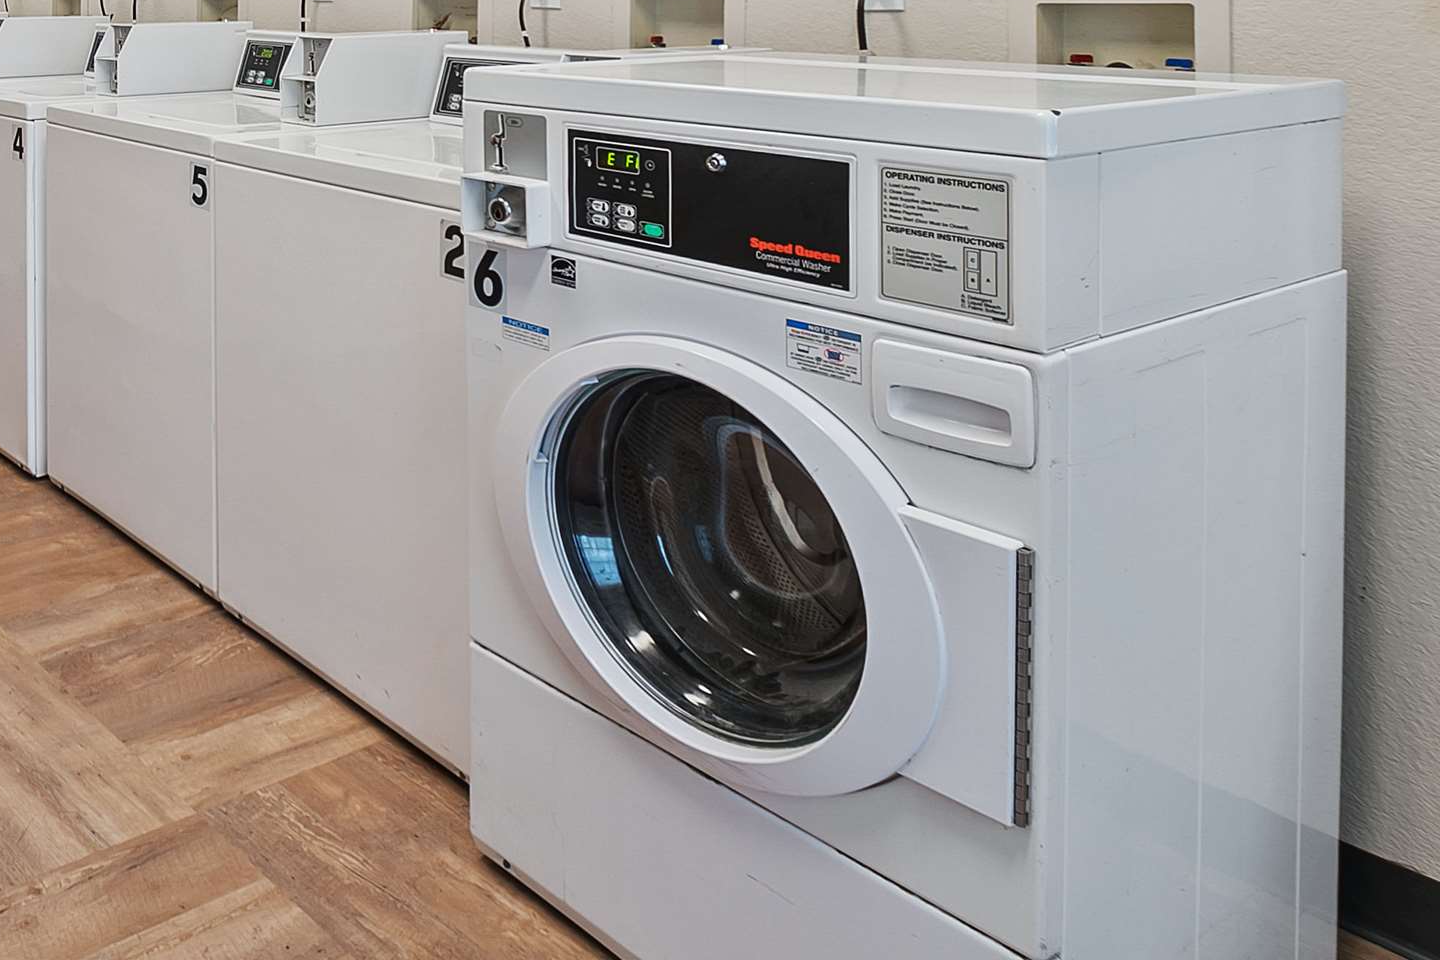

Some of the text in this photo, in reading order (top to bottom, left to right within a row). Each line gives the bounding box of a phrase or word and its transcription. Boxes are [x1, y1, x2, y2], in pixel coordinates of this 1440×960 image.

[13, 127, 24, 159] 4
[191, 166, 208, 206] 5
[885, 171, 1005, 193] OPERATING INSTRUCTIONS
[750, 237, 840, 263] Speed Queen
[886, 225, 1005, 250] DISPENSER INSTRUCTIONS
[444, 225, 464, 278] 2
[755, 250, 832, 273] Commercial Washer
[474, 250, 503, 307] 6
[793, 268, 821, 278] Efficiency
[508, 319, 546, 333] NOTICE
[808, 325, 839, 336] NOTICE
